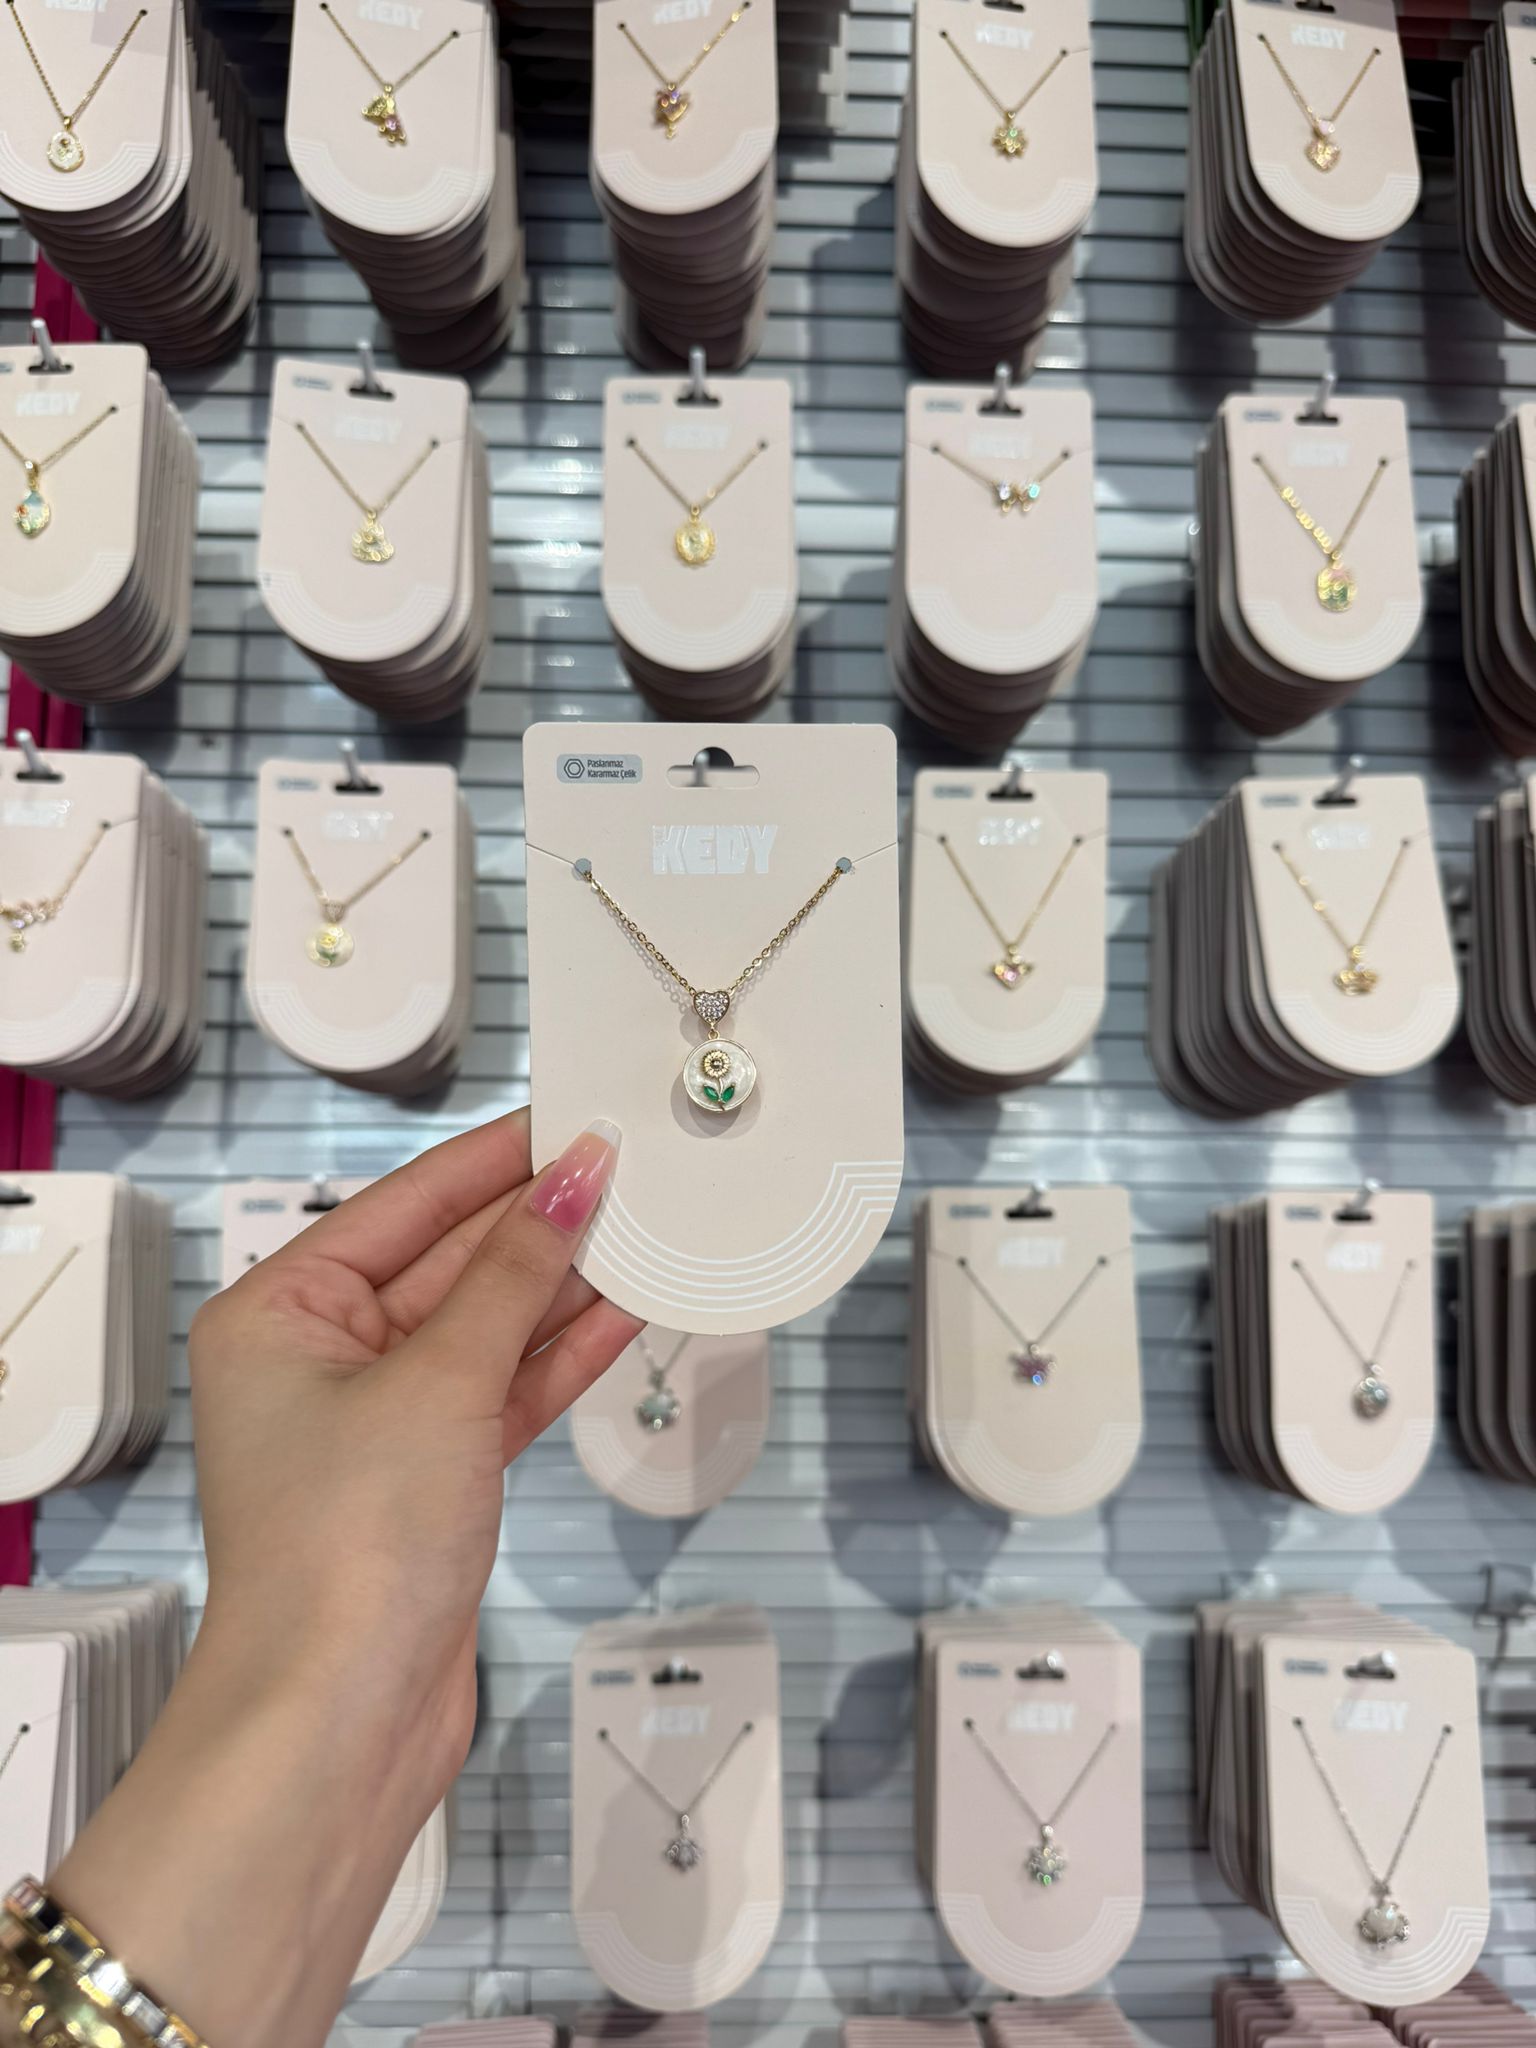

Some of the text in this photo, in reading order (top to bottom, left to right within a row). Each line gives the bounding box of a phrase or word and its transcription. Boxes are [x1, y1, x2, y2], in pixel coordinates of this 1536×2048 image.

[587, 759, 624, 768] Paslanmaz
[587, 769, 637, 779] Kararmaz Çelik
[652, 825, 778, 874] KEDY
